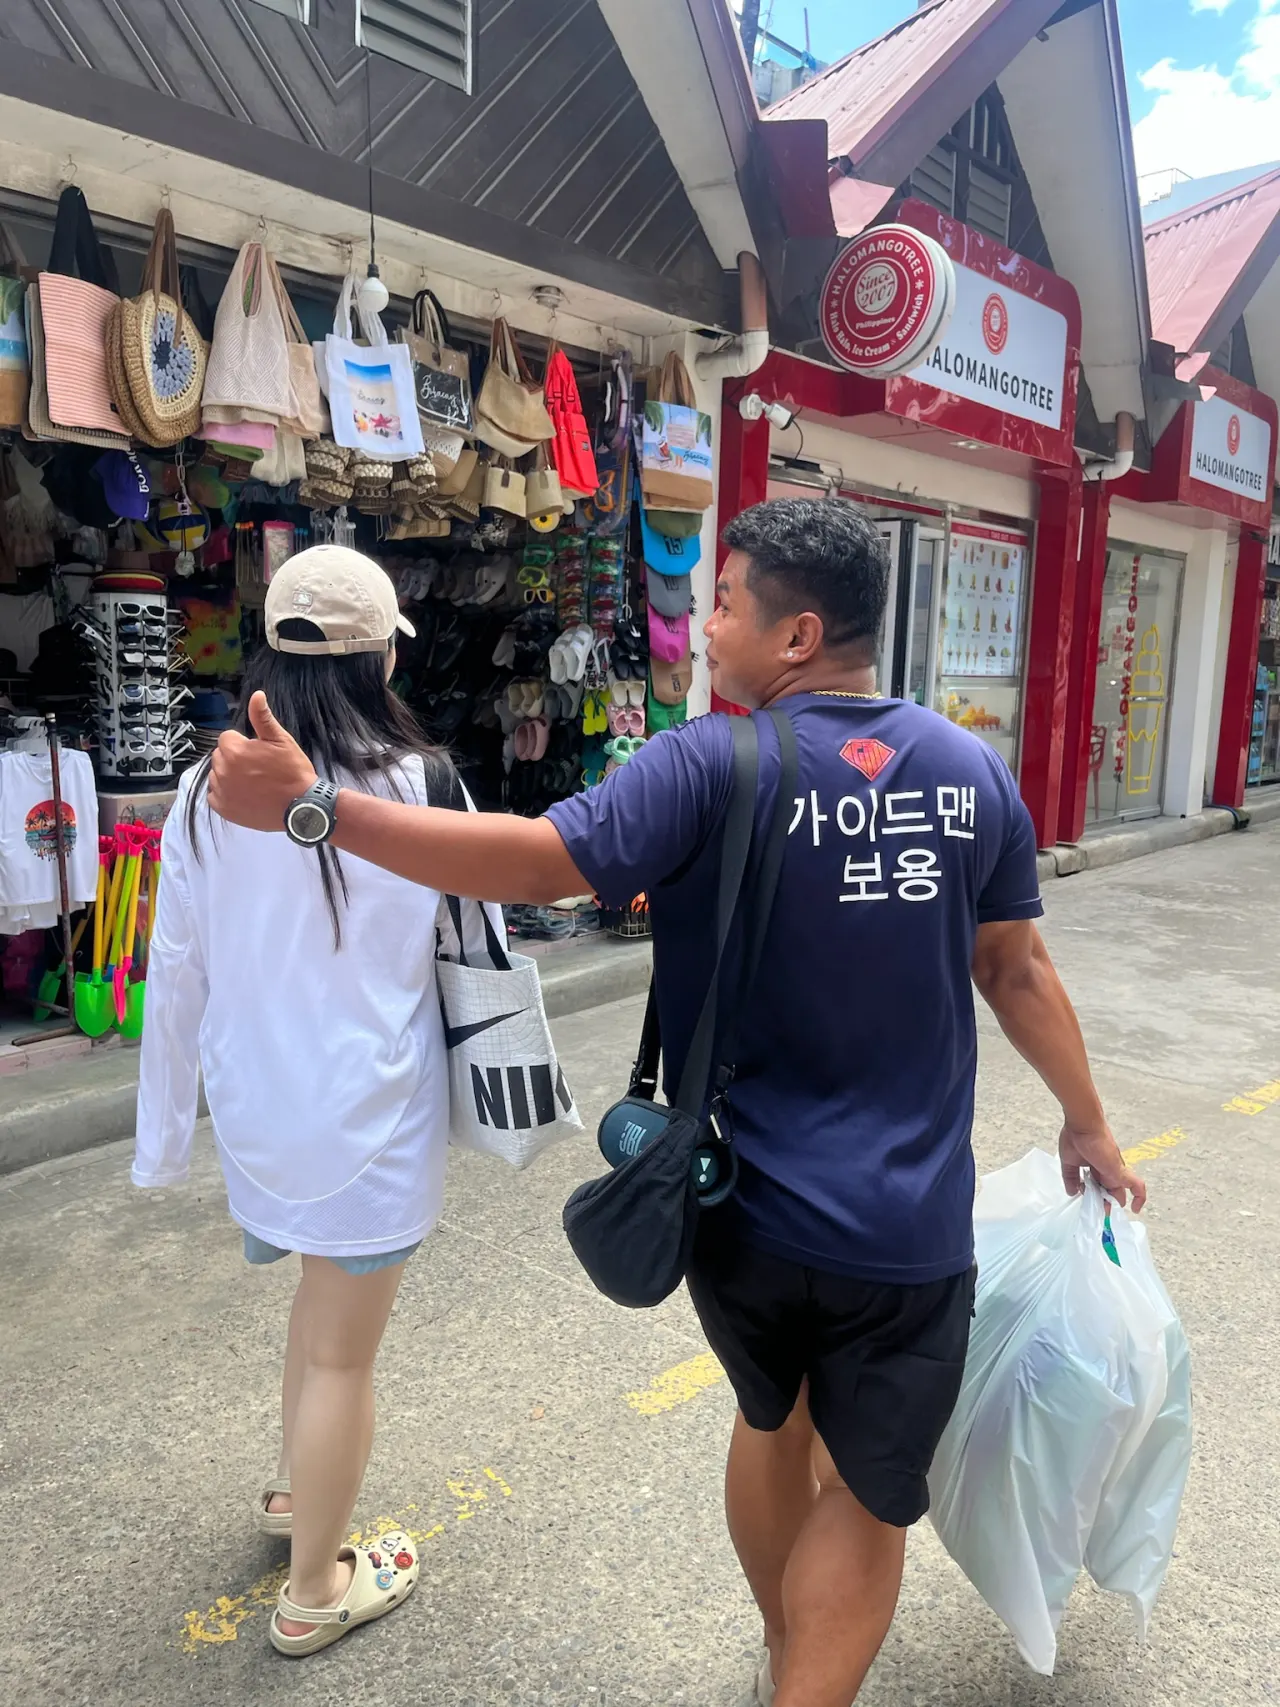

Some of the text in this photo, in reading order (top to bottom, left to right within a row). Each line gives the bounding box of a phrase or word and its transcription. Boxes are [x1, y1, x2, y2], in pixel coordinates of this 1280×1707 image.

[832, 239, 925, 295] HALOMANGOTREE
[857, 269, 892, 295] Since
[861, 281, 895, 309] 2007
[829, 311, 840, 334] Halo
[852, 343, 863, 356] Ice
[864, 342, 891, 357] Cream
[896, 293, 925, 341] Sandwich
[855, 316, 895, 330] Philippines
[926, 345, 1054, 411] ALOMANGOTREE
[1195, 452, 1262, 490] HALOMANGOTREE
[787, 785, 976, 847] 가이드맨
[838, 848, 943, 902] 보용
